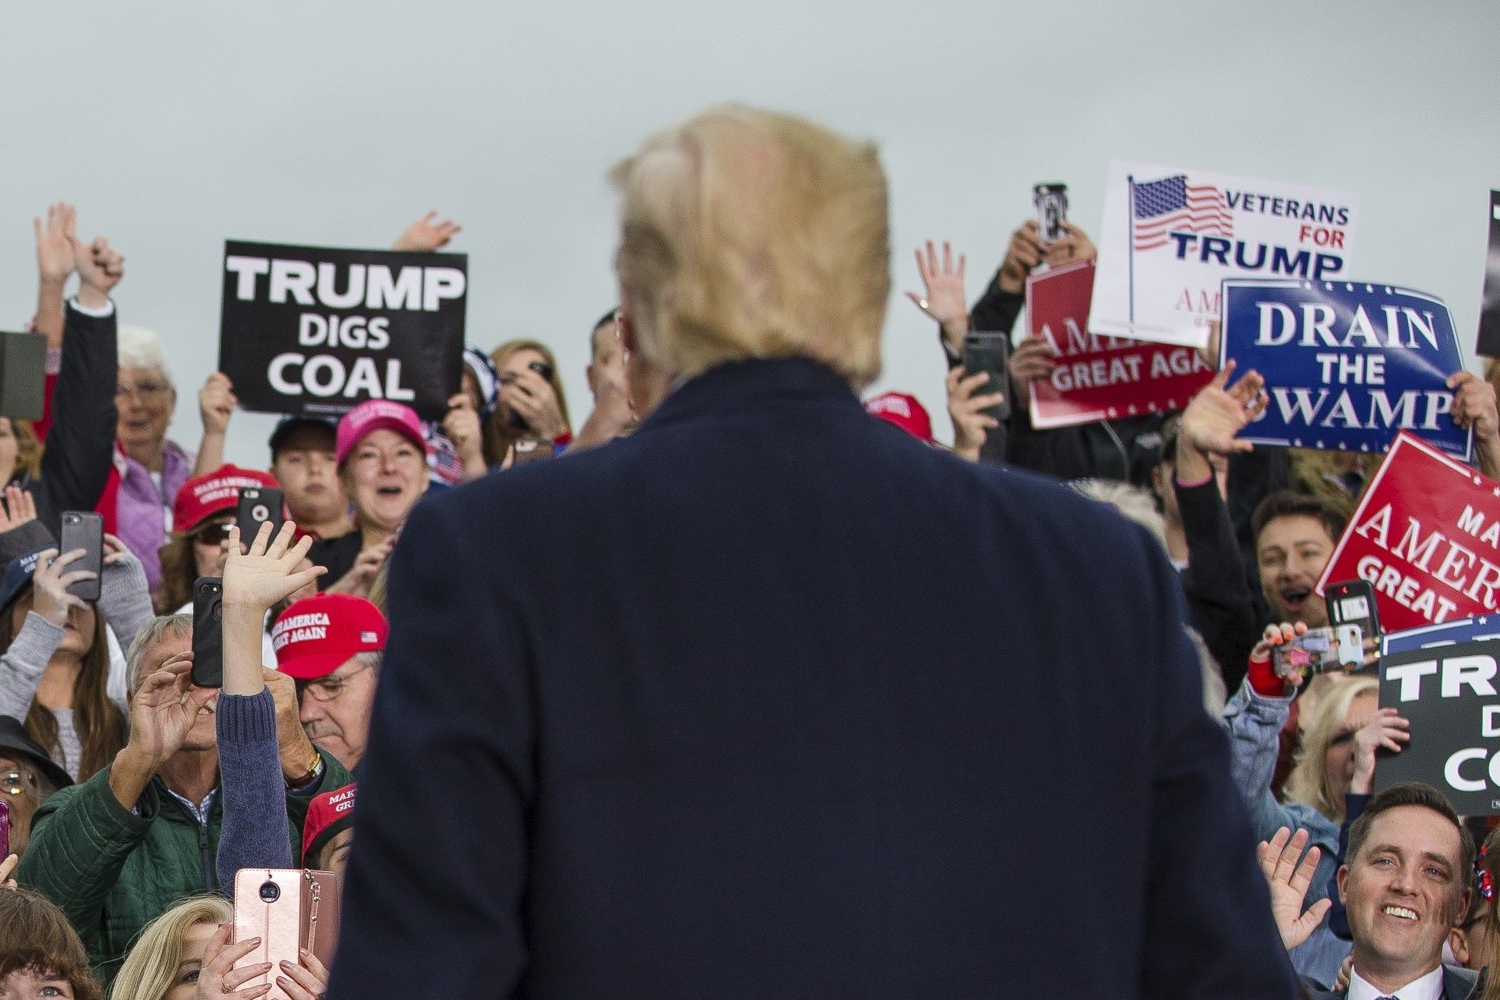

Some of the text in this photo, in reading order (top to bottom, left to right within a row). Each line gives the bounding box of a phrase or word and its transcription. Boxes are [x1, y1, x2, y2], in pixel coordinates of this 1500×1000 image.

[1226, 191, 1349, 225] VETERANS
[1169, 232, 1344, 279] TRUMP
[1299, 226, 1344, 249] FOR
[226, 255, 467, 312] TRUMP
[298, 313, 390, 350] DIGS
[1254, 301, 1438, 351] DRAIN
[267, 353, 415, 400] COAL
[1051, 356, 1142, 392] GREAT
[1316, 354, 1386, 385] THE
[1356, 554, 1457, 625] GREAT
[282, 613, 330, 631] AMERICA
[290, 627, 327, 643] AGAIN
